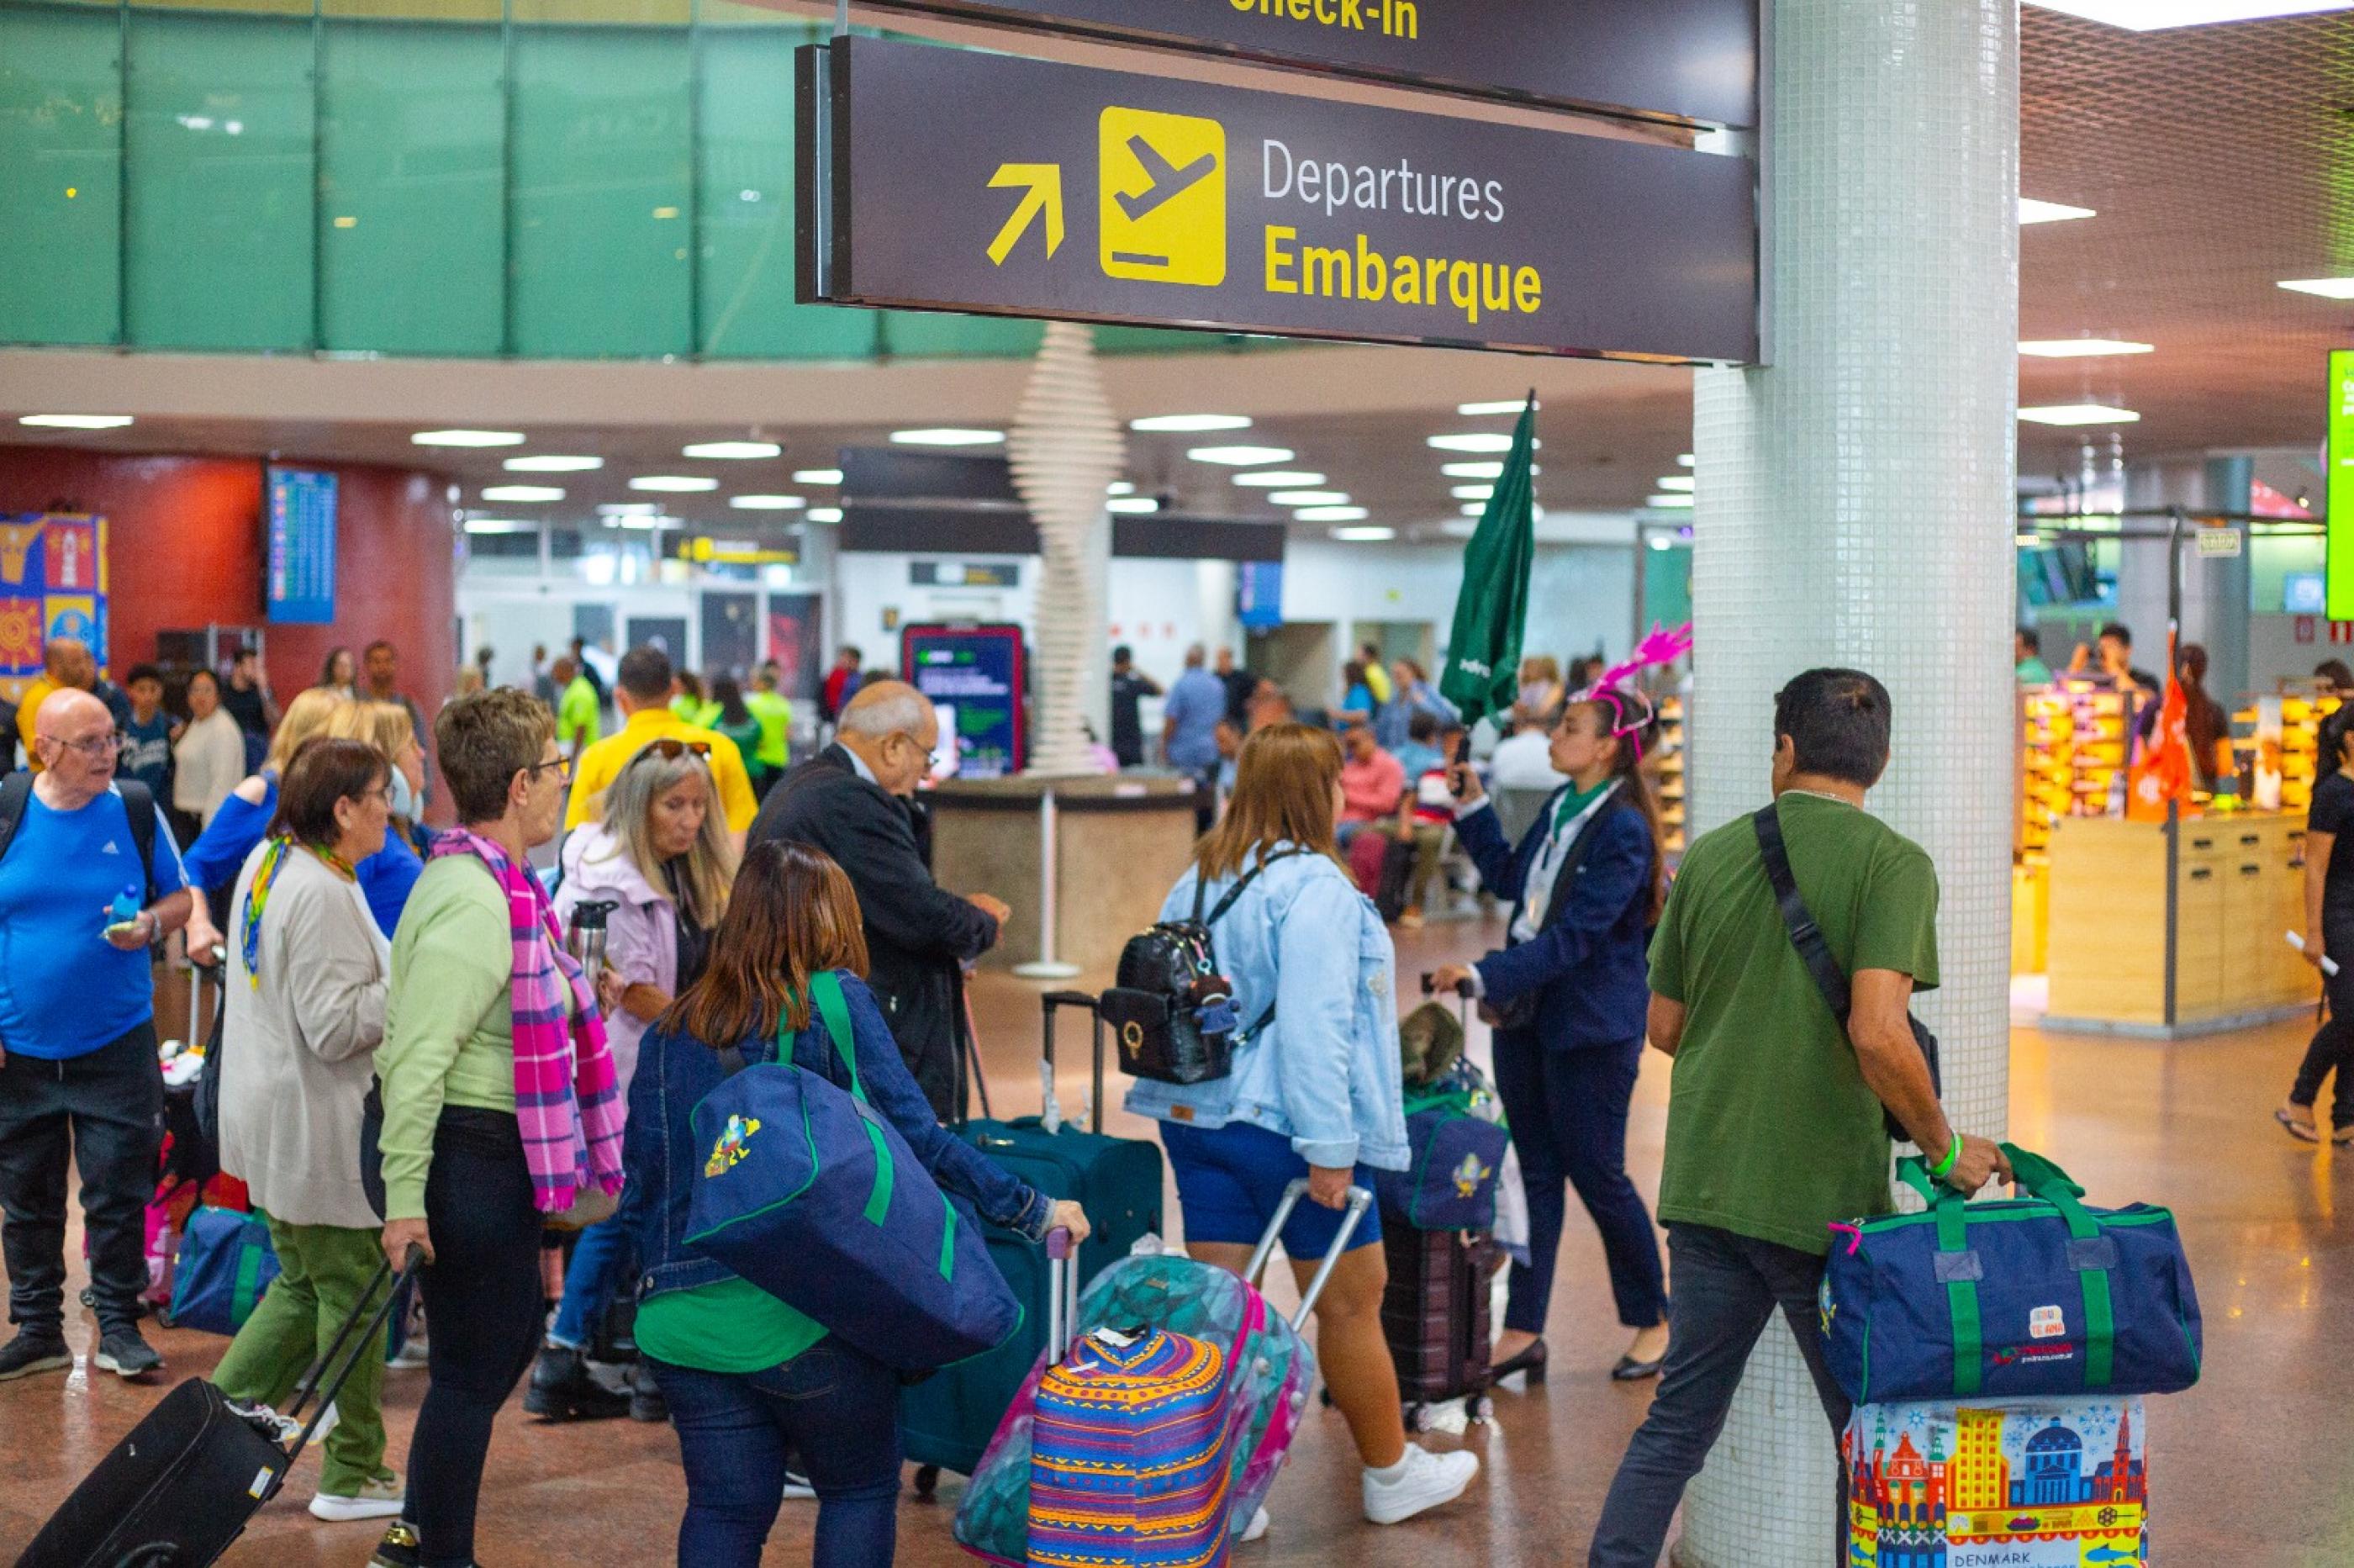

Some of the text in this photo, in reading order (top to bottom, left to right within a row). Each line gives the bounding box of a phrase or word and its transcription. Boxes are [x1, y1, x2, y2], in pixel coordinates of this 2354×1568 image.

[1229, 0, 1417, 40] eck-in
[1263, 139, 1505, 223] Departures
[1264, 224, 1542, 324] Embarque
[1955, 1553, 2031, 1567] DENMARK
